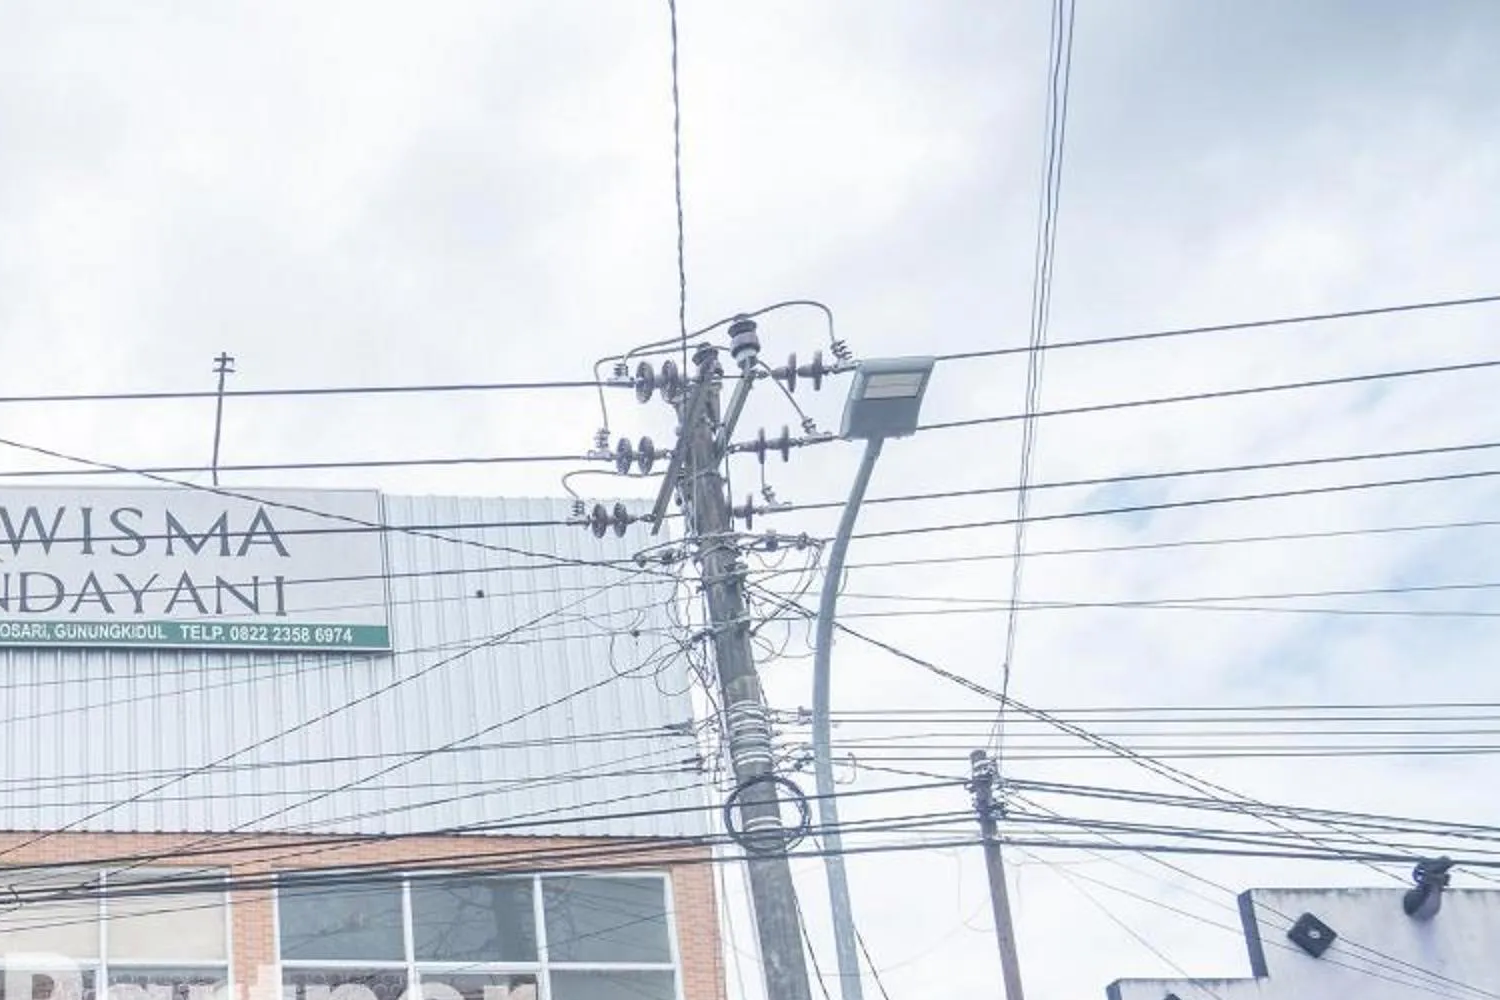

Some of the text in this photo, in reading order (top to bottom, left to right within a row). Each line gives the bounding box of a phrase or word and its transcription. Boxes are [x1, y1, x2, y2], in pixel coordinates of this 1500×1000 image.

[54, 623, 167, 641] GUNUNGKIDUL
[180, 624, 227, 641] TELP.
[229, 626, 269, 642] 0822
[272, 626, 310, 642] 2358
[315, 627, 353, 643] 6974
